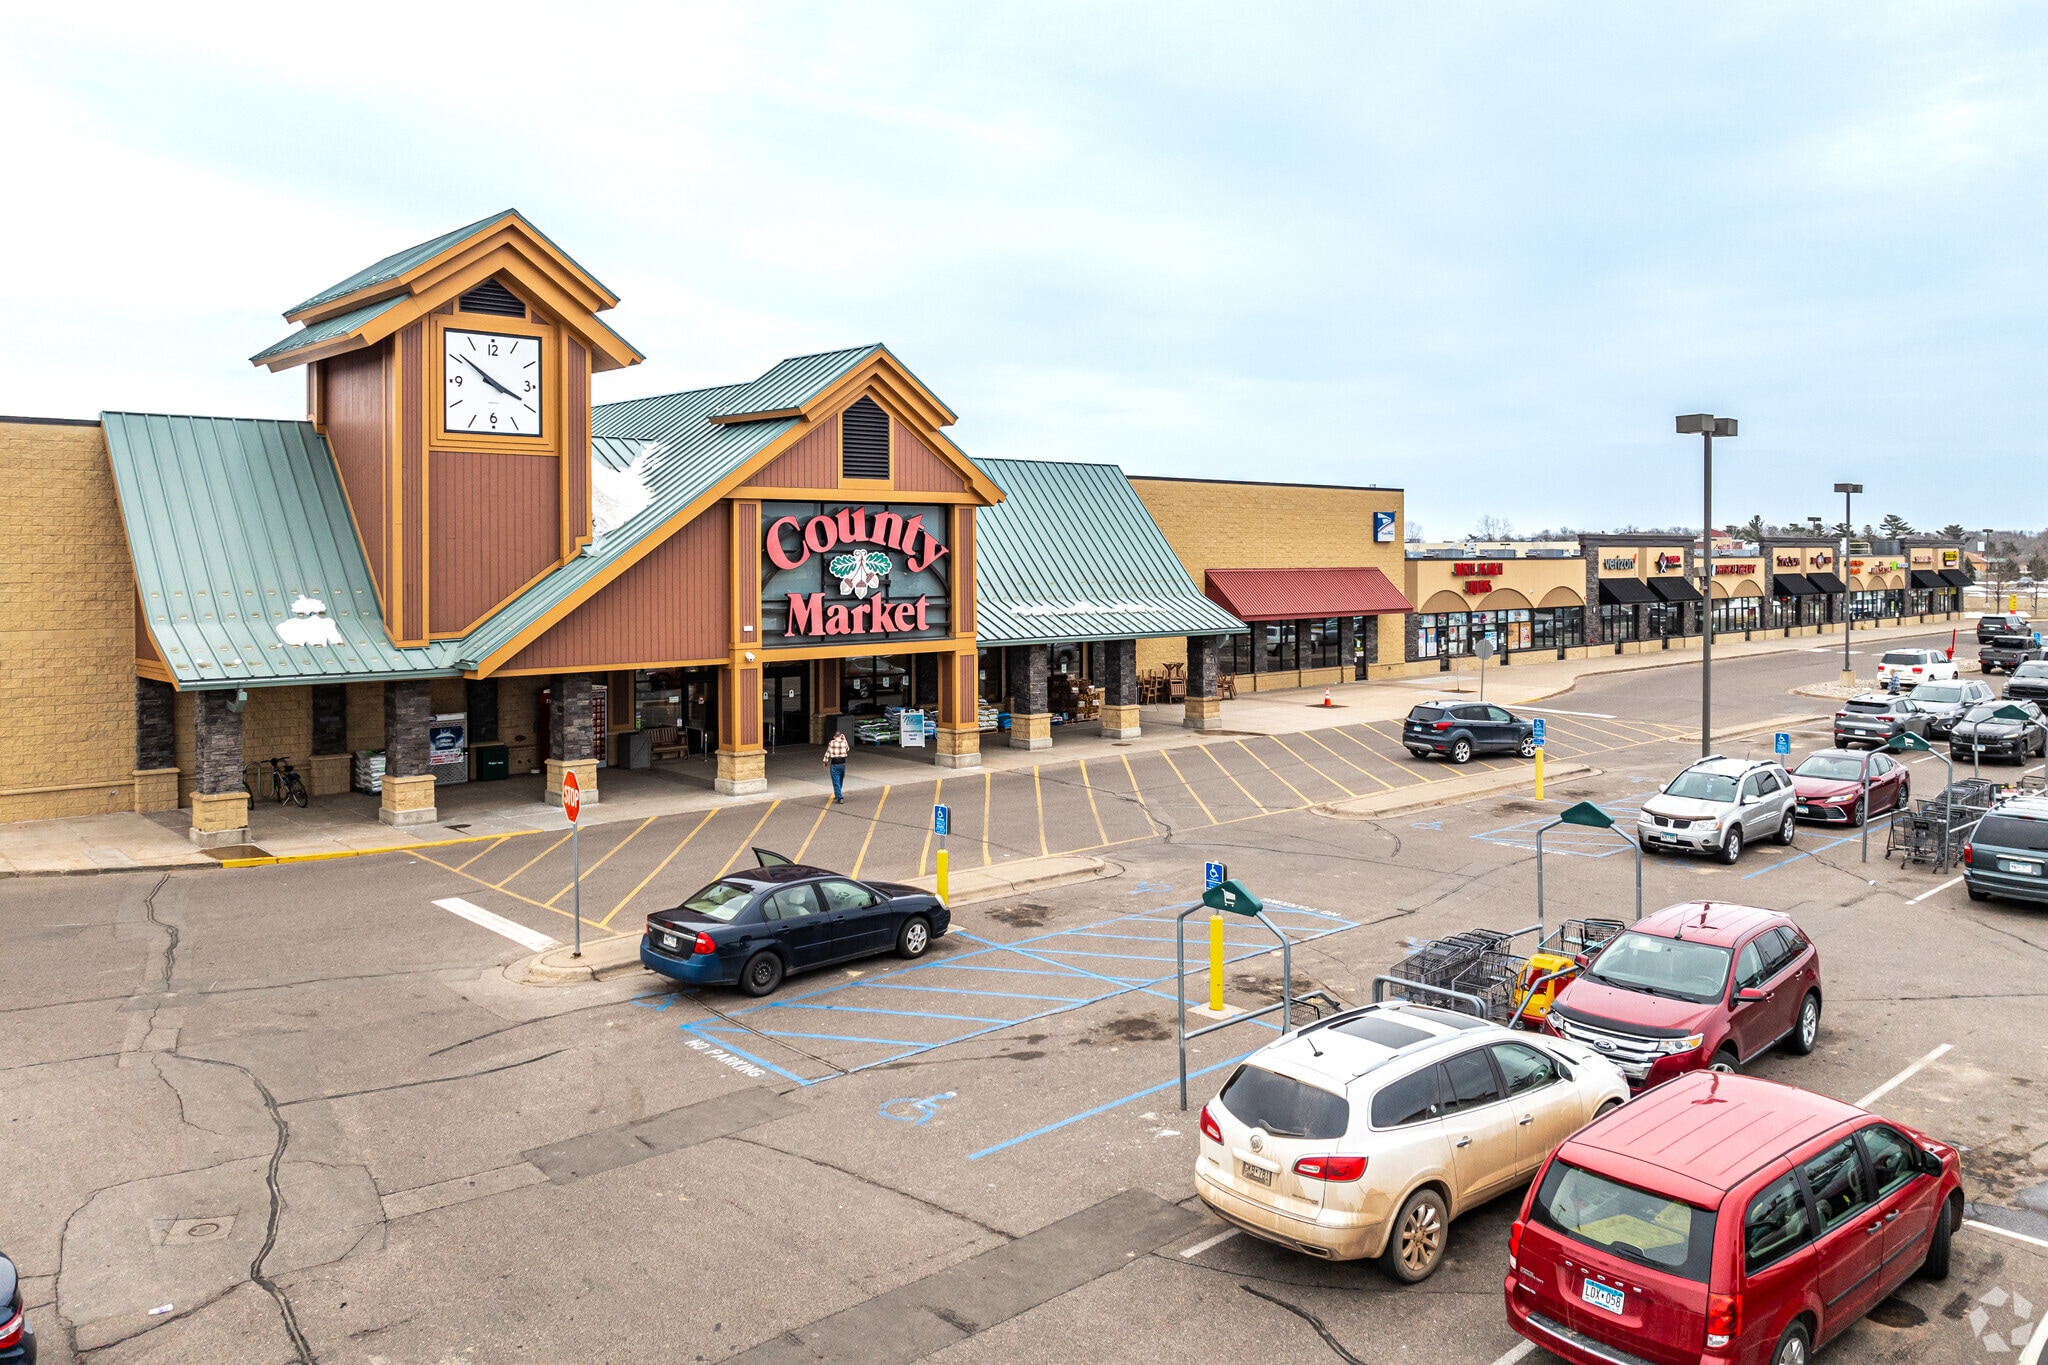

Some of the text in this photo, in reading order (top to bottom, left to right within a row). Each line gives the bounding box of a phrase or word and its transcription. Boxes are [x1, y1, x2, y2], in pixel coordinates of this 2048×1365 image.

[487, 344, 499, 357] 12
[454, 375, 463, 387] 9
[524, 380, 531, 392] 3
[489, 412, 498, 424] 6
[766, 506, 950, 573] County
[1604, 555, 1634, 570] verizon
[784, 591, 931, 638] Market
[564, 785, 579, 808] STOP
[684, 1039, 711, 1050] NO
[704, 1048, 766, 1077] PARKING
[1585, 1284, 1601, 1301] LDX
[1605, 1292, 1622, 1308] 058
